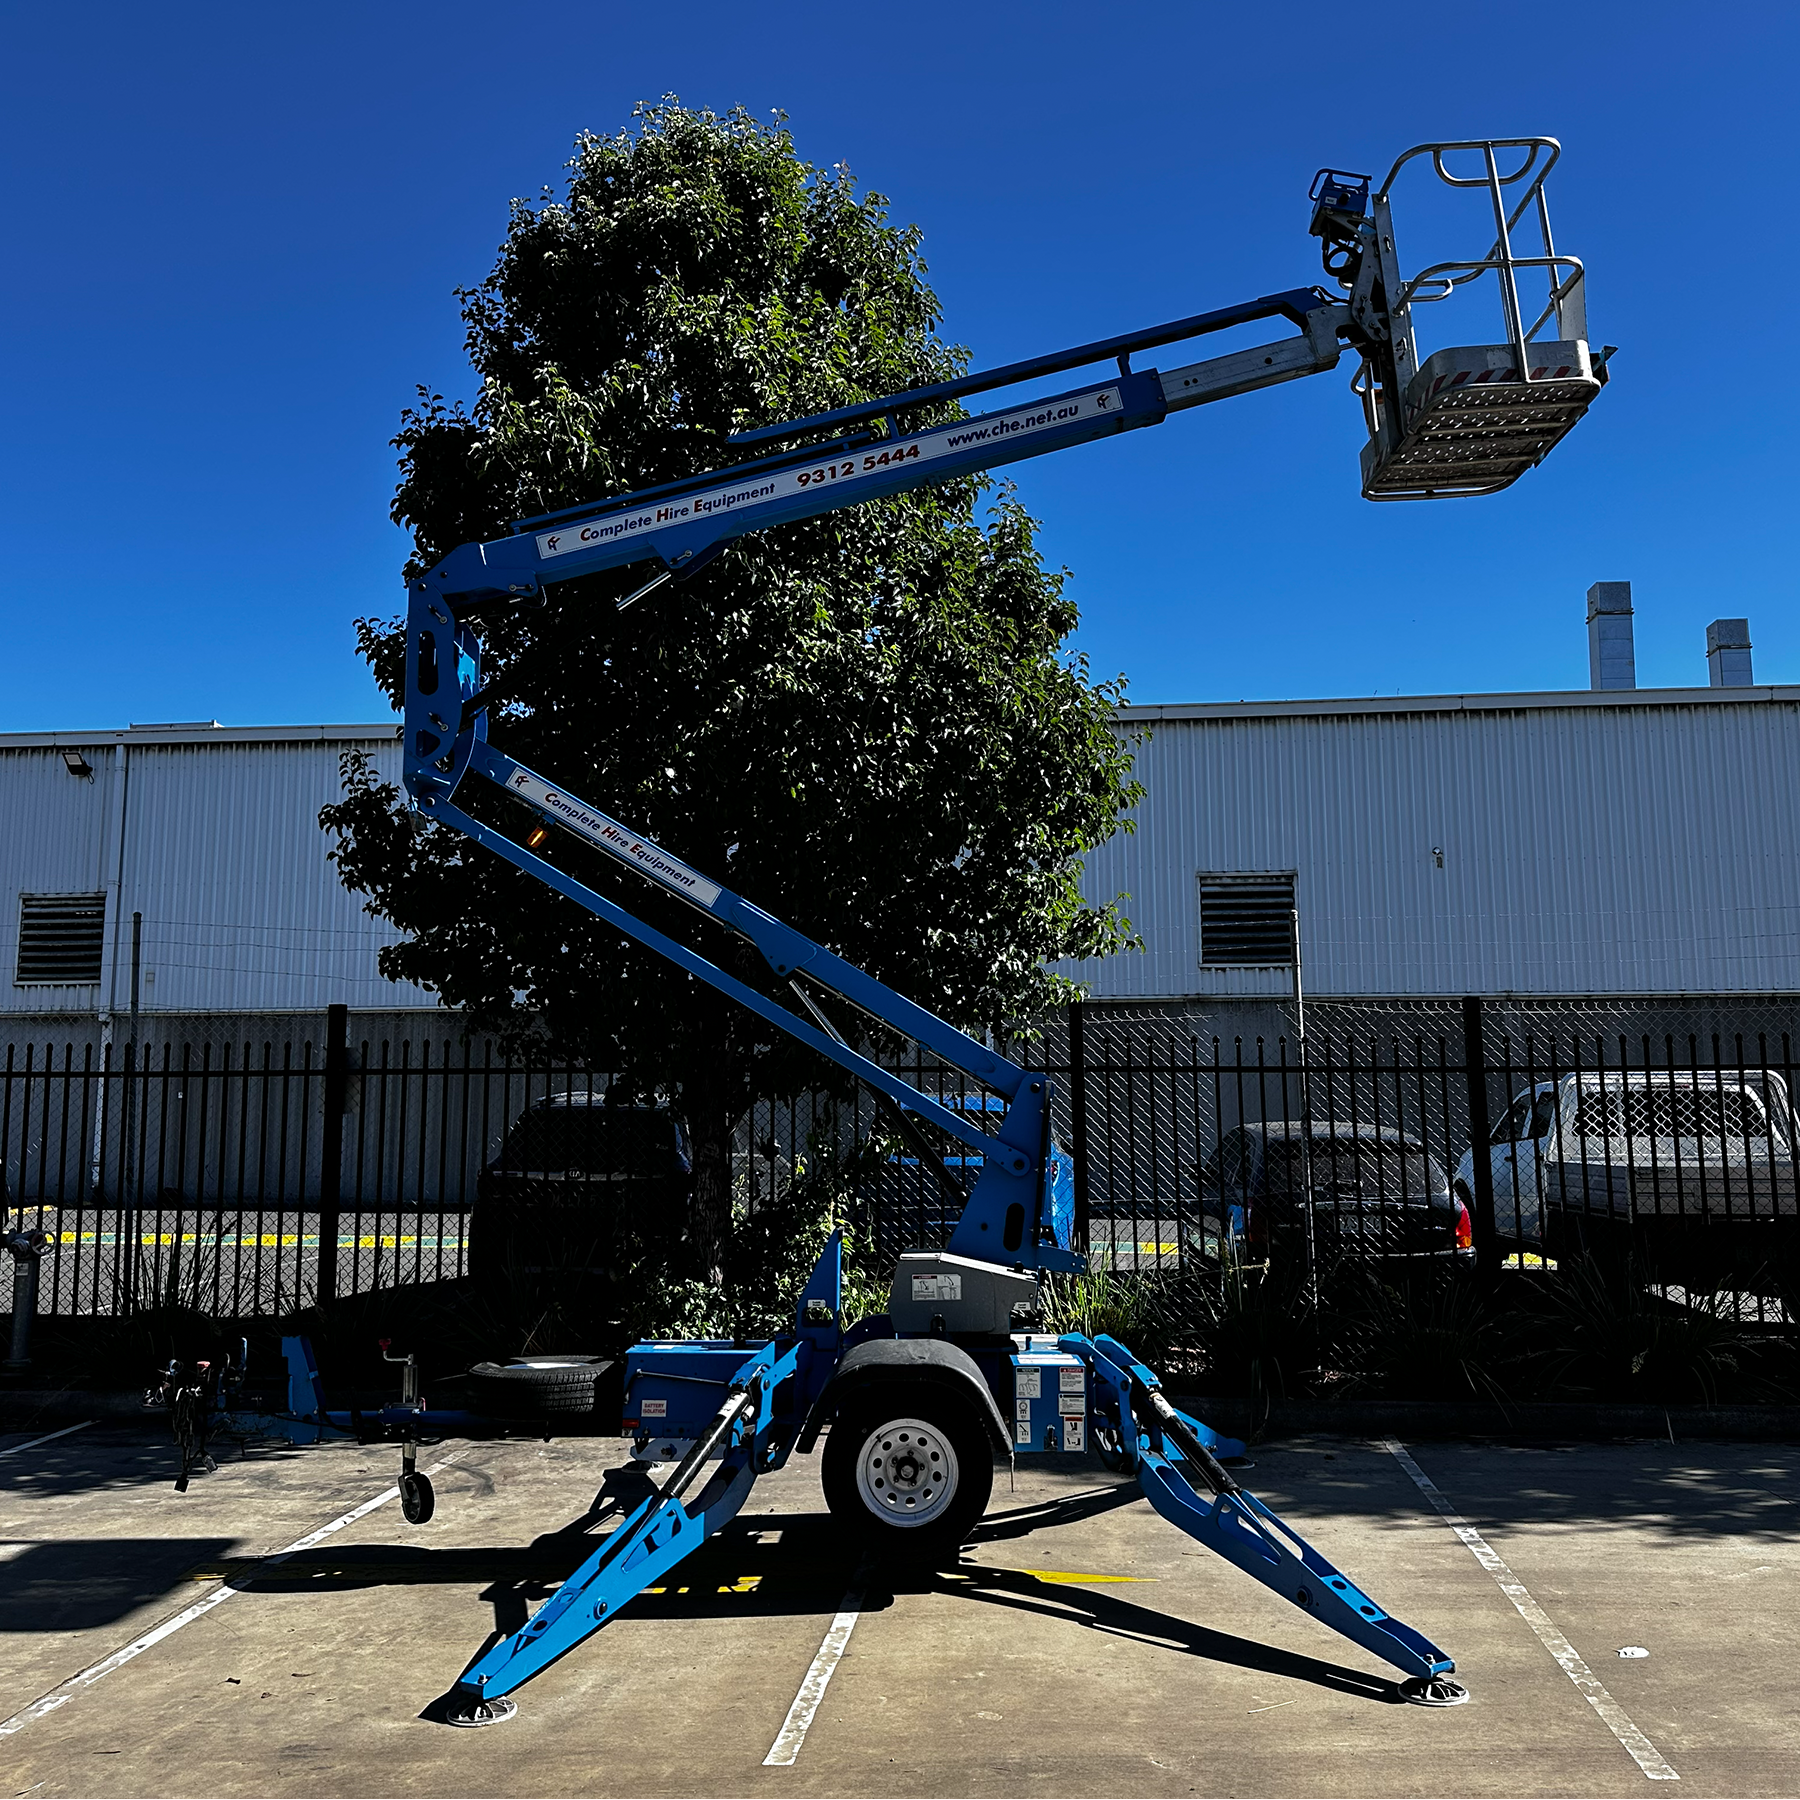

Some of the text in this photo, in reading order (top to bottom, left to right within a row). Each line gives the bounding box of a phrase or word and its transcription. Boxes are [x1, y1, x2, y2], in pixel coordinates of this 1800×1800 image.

[580, 404, 1079, 541] Complete Hire Equipment 9312 5444 www.che.net.au
[545, 793, 696, 888] Complete Hire Equipment
